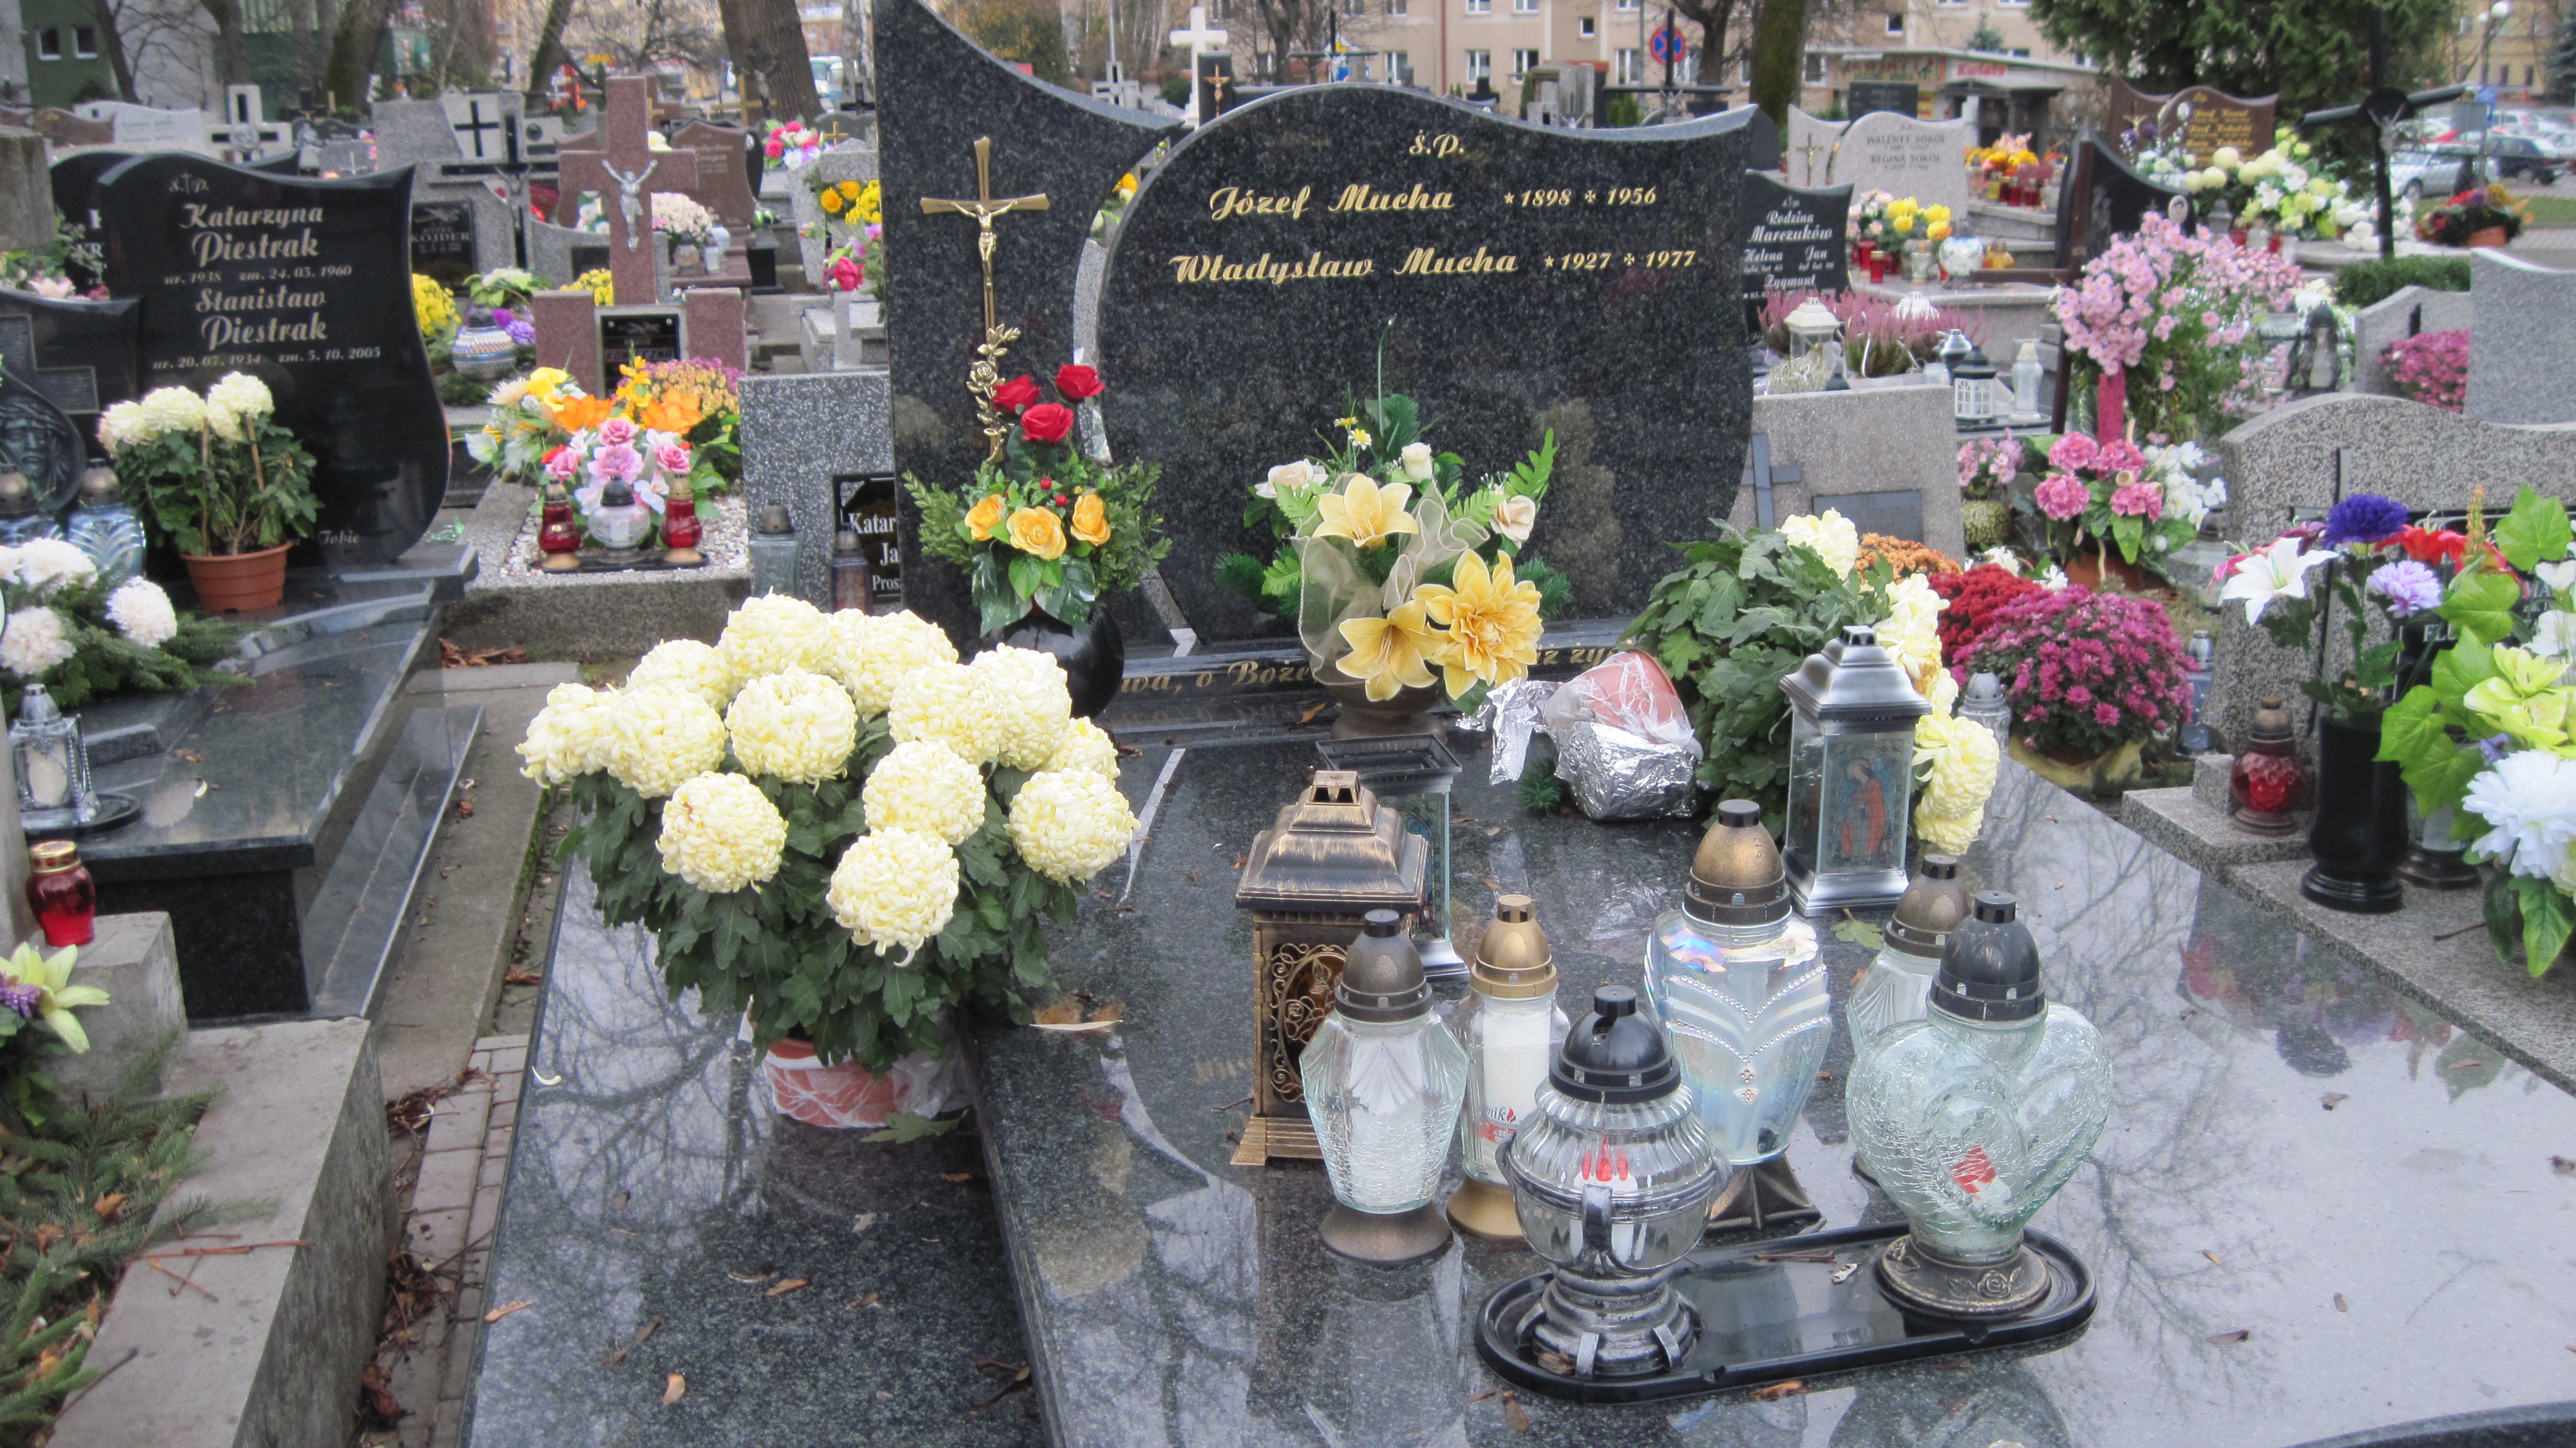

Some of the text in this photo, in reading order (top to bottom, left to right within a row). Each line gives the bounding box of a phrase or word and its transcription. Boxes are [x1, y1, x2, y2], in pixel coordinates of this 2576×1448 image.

[179, 203, 324, 229] Katarzyna
[1209, 183, 1658, 220] Józef Mucha 1898 1956
[191, 227, 319, 267] Piestrak
[1169, 246, 1696, 285] Władysław Mucha 1927 1977
[195, 284, 327, 312] Stanisław
[200, 312, 328, 351] Piestrak
[1196, 671, 1213, 687] o
